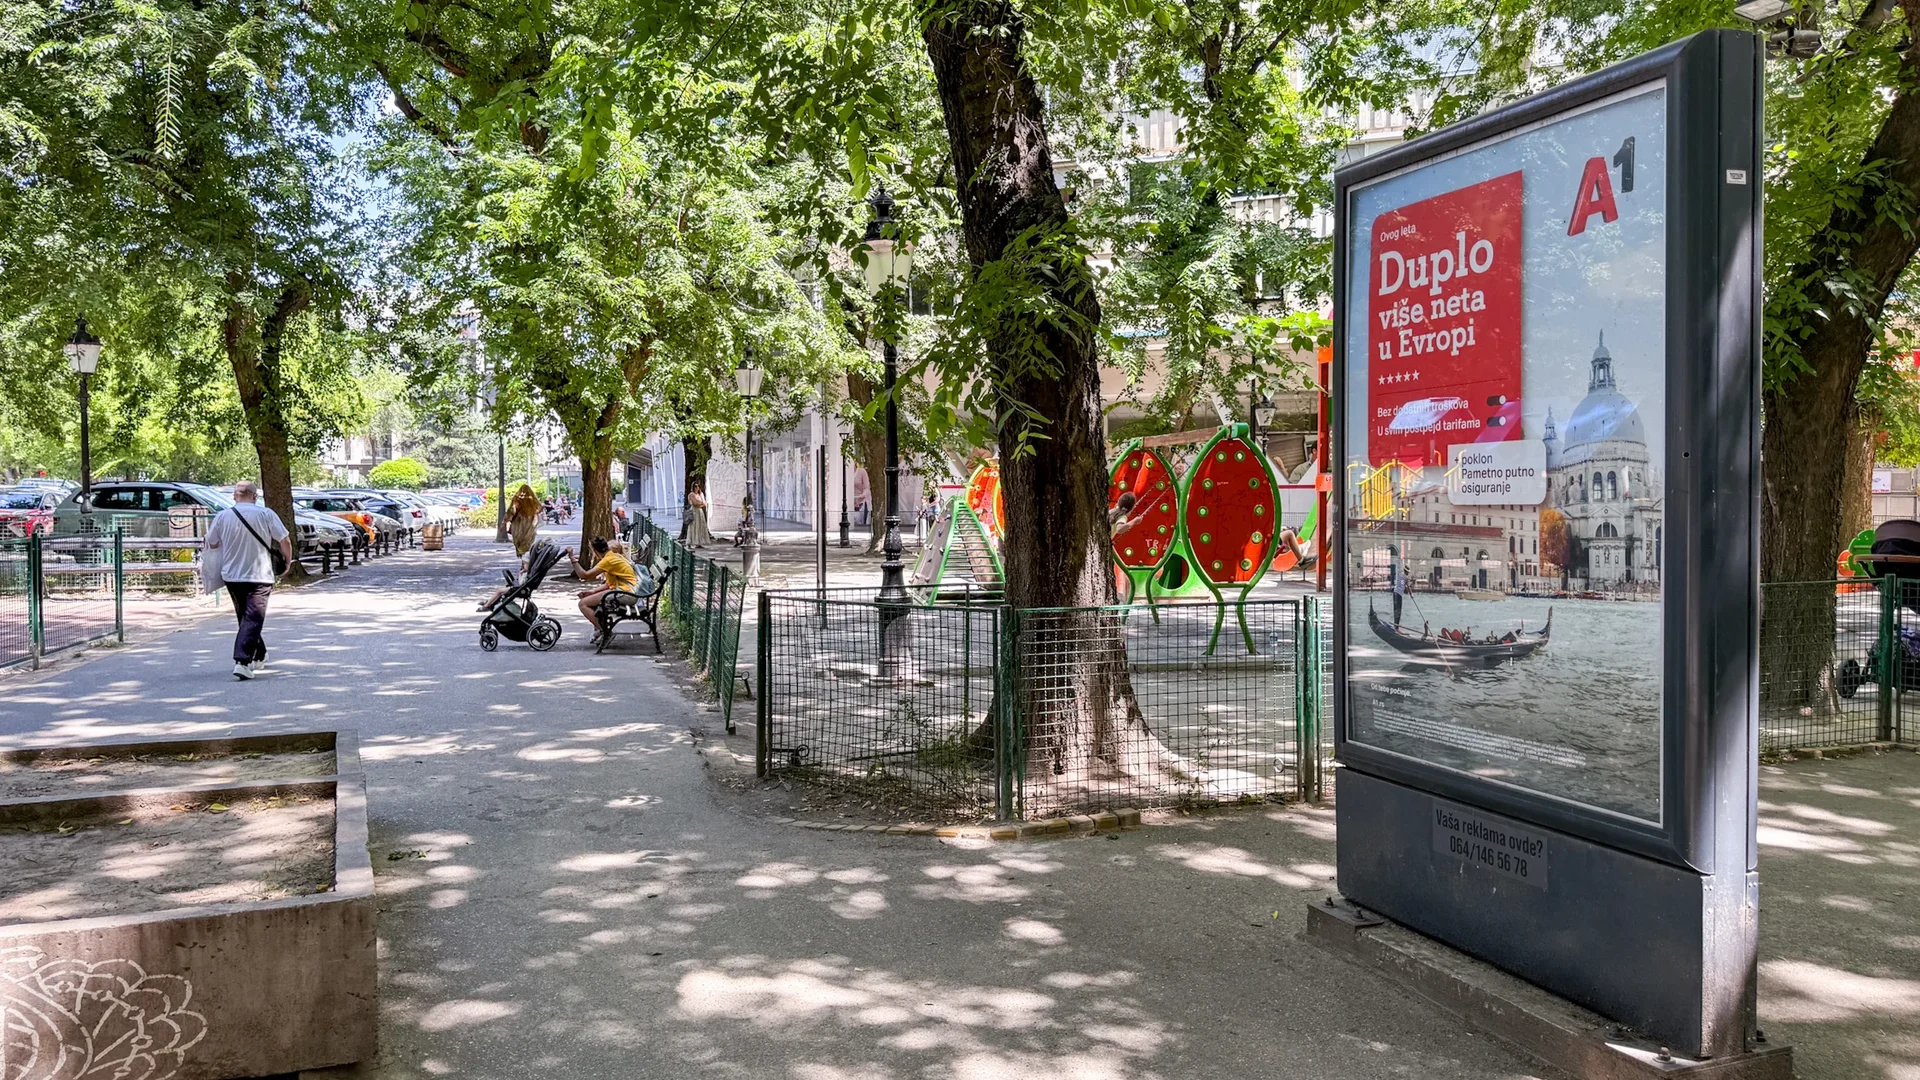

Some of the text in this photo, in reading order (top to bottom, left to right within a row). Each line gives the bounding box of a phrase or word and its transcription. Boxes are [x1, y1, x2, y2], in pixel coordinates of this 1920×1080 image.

[1567, 136, 1635, 237] A1
[1380, 224, 1416, 242] Ovog leta
[1379, 231, 1494, 296] Duplo
[1379, 287, 1486, 330] više neta
[1378, 318, 1476, 360] u Evropi
[1377, 407, 1392, 418] Bez
[1431, 399, 1469, 412] troškova
[1377, 426, 1384, 436] U
[1404, 420, 1441, 437] postpejd
[1442, 418, 1481, 431] tarifama
[1461, 454, 1493, 468] poklon
[1461, 466, 1535, 480] Pametno putno
[1461, 482, 1511, 496] osiguranje
[1436, 808, 1543, 858] Vaša reklama ovde?
[1450, 835, 1528, 877] 064/146 56 78
